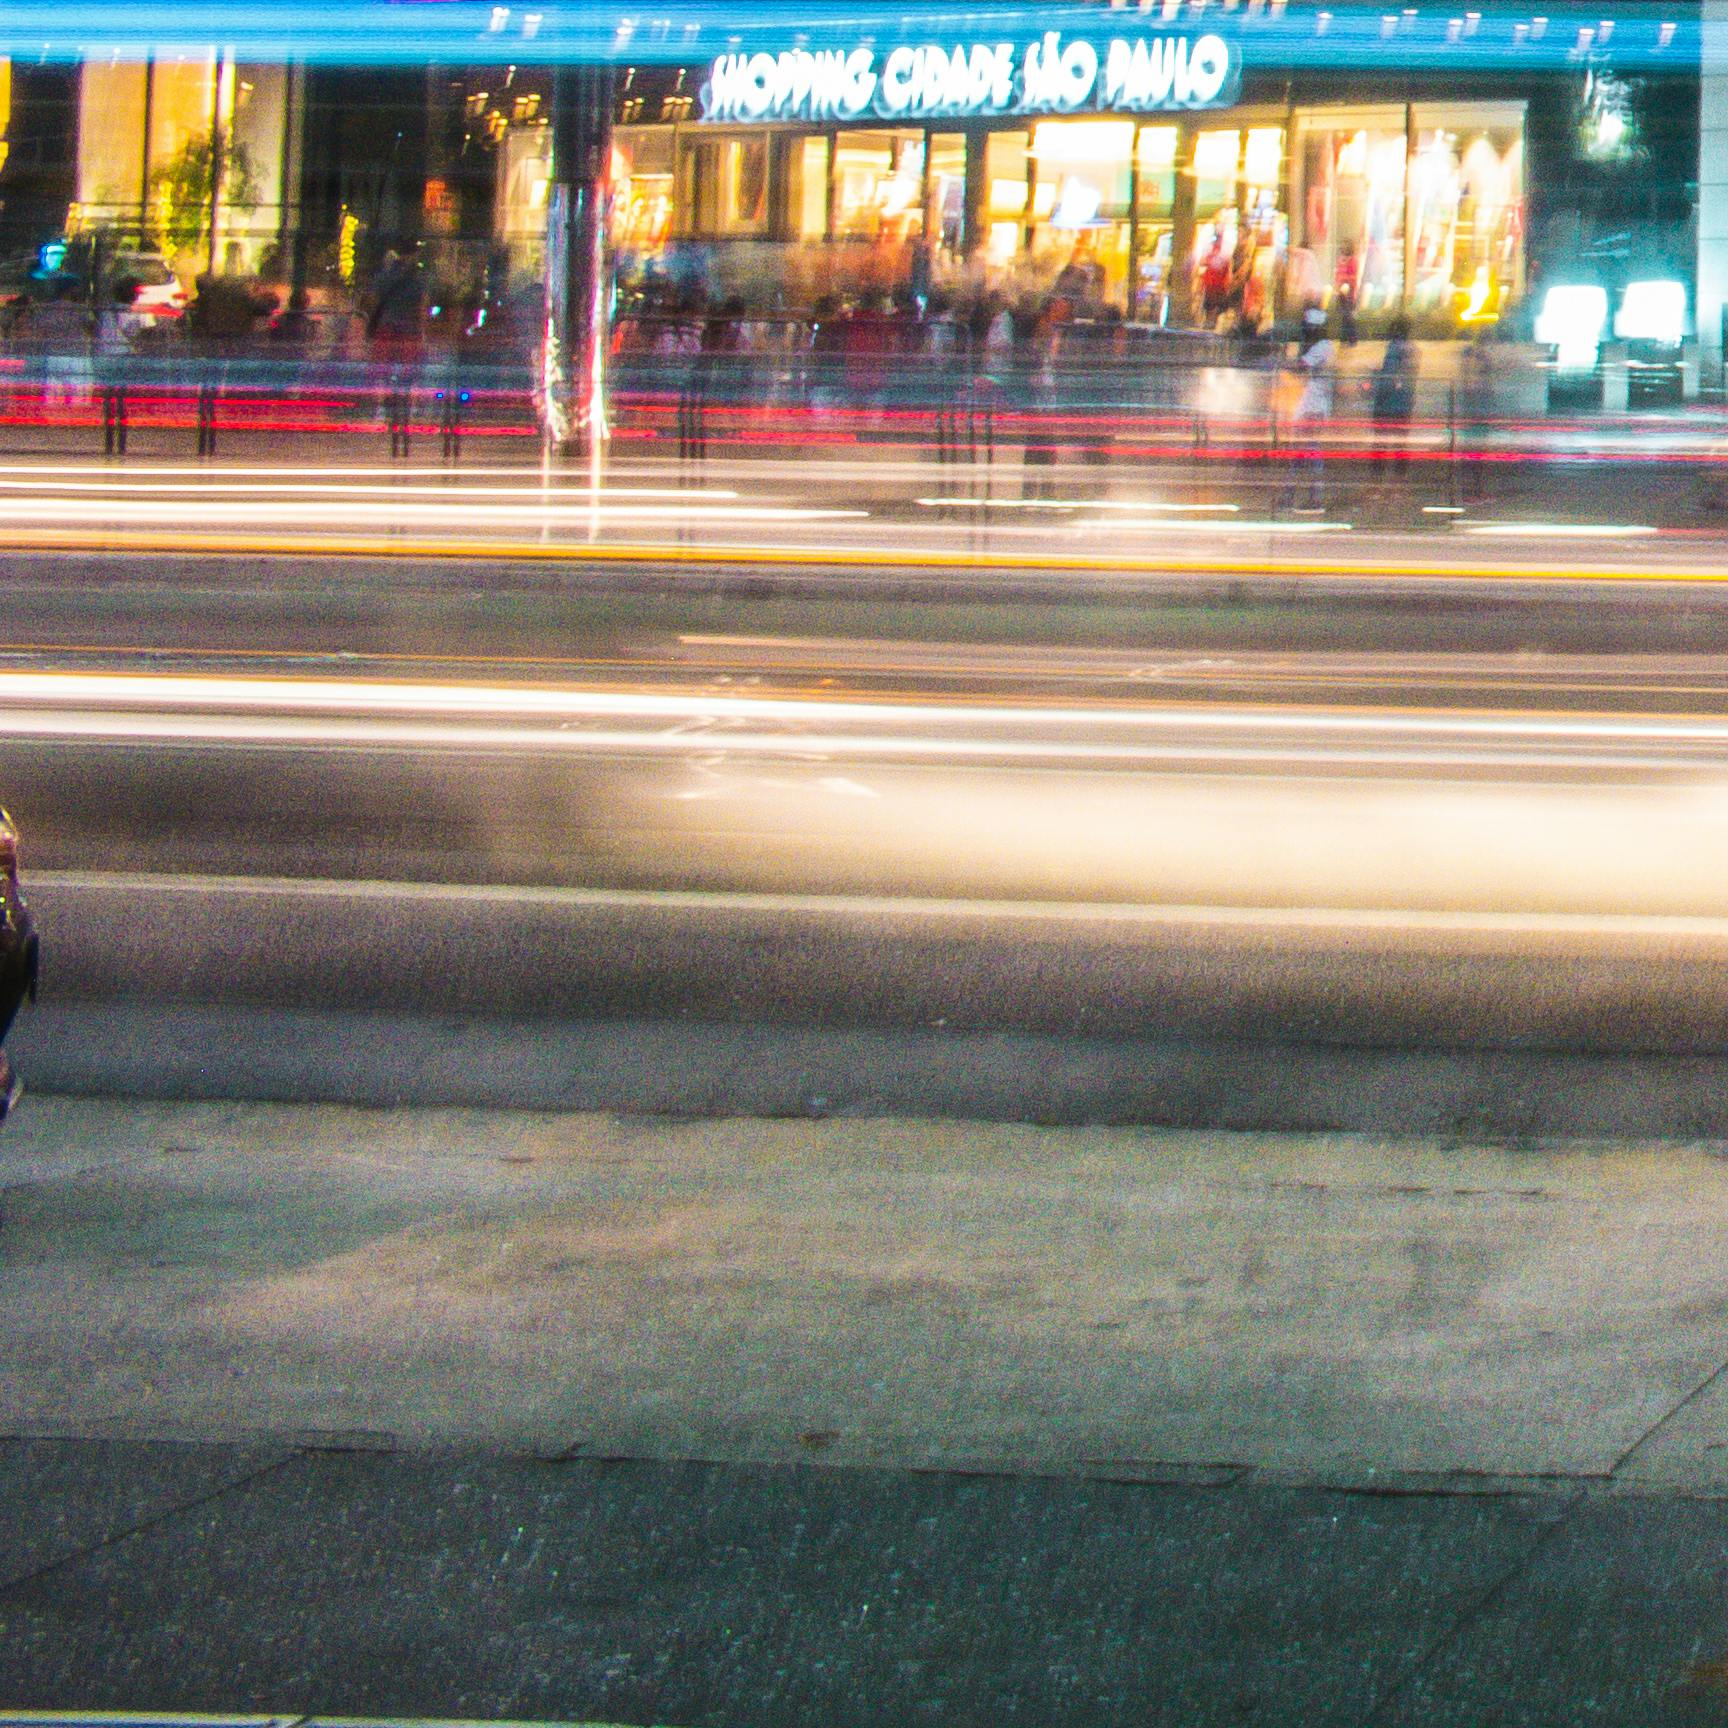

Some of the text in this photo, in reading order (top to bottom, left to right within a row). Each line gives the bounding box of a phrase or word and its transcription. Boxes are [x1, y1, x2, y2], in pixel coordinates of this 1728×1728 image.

[706, 31, 1231, 119] SHOPPING CIDADE SÃO PAULO
